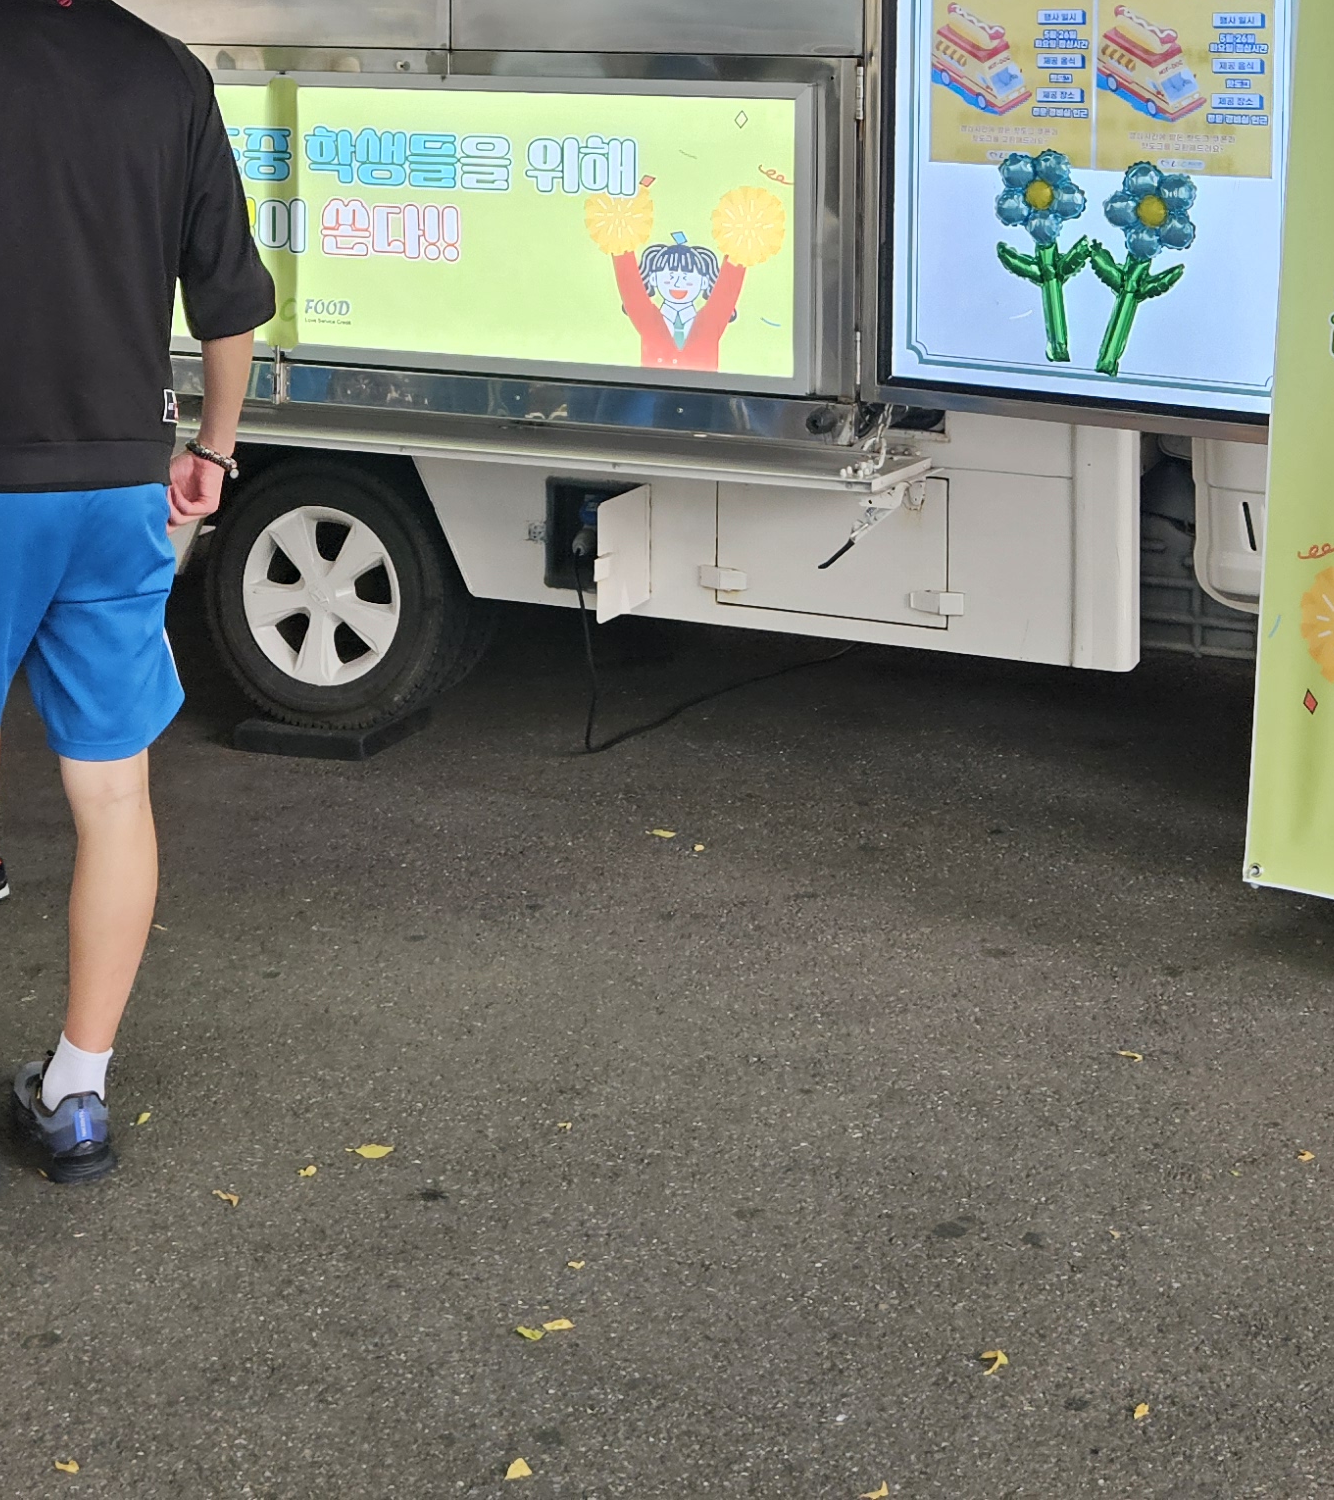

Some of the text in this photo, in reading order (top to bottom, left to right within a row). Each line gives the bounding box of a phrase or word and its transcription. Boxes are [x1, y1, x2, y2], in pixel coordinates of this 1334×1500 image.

[304, 125, 513, 192] 학생들을
[526, 135, 638, 197] 위해
[320, 196, 461, 262] 쓴다!!
[304, 299, 350, 316] FOOD
